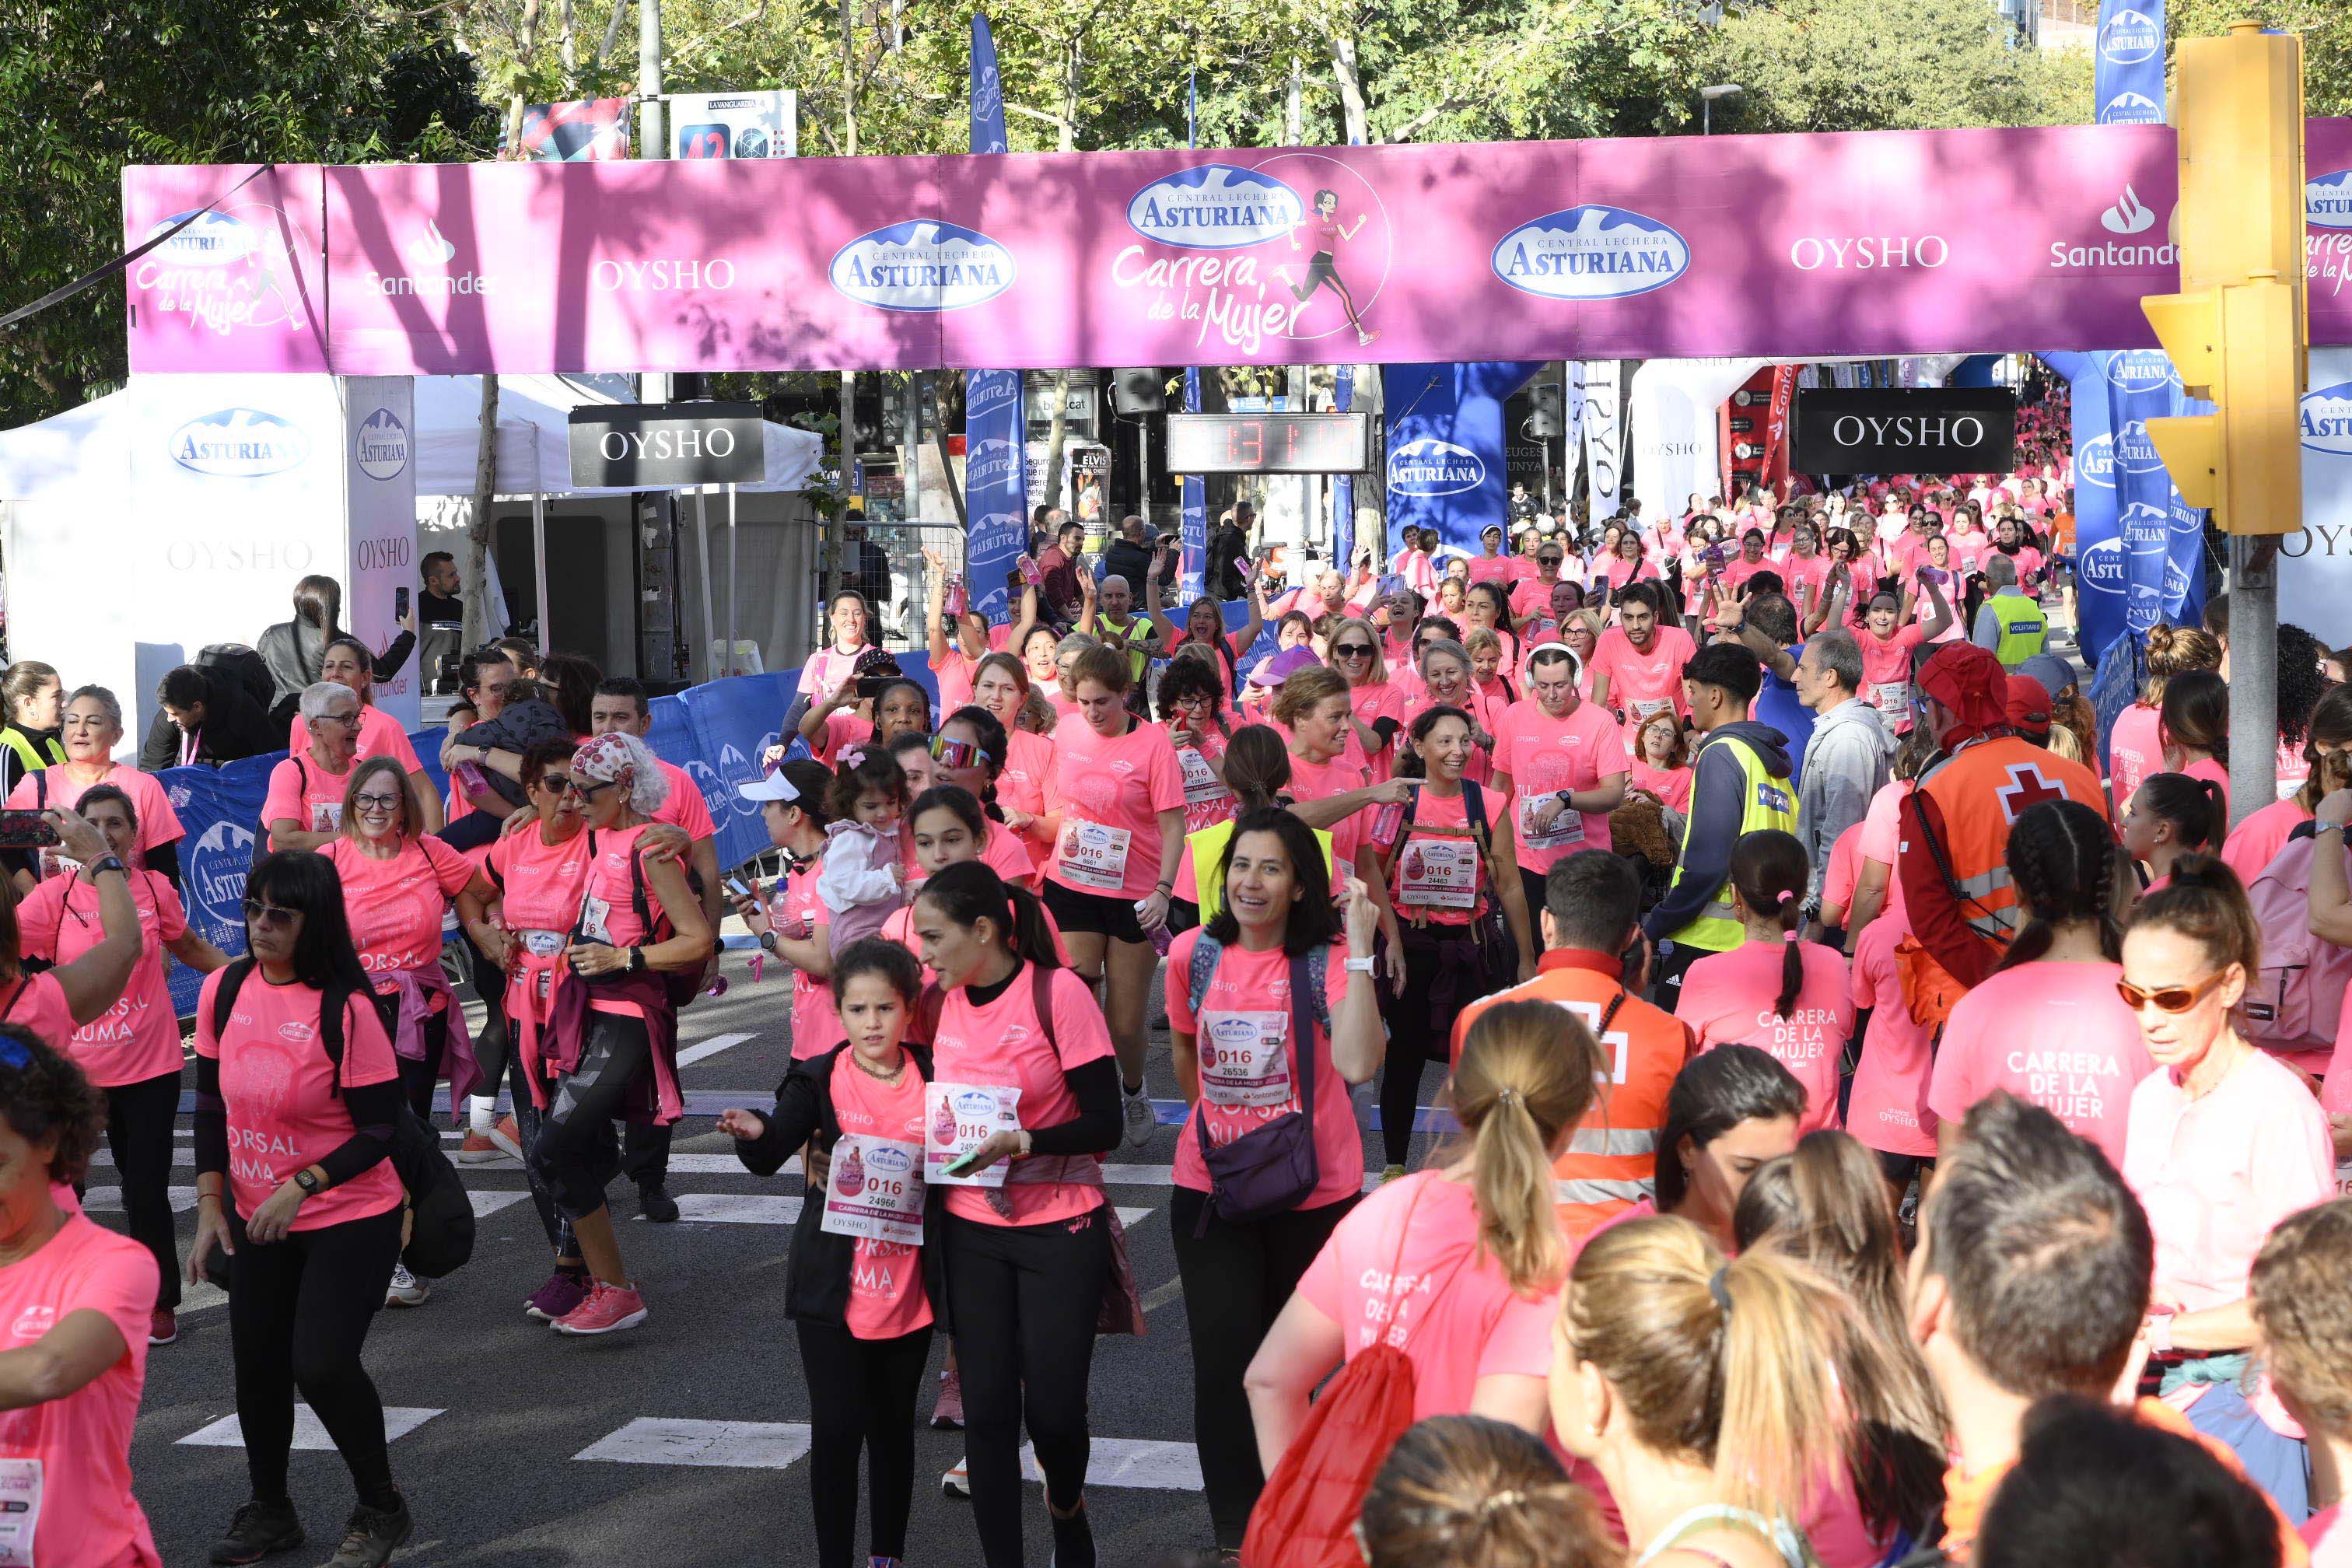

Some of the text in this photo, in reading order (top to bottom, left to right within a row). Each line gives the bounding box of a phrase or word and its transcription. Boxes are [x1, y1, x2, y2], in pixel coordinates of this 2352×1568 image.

[2106, 35, 2154, 51] ASTURIANA
[718, 100, 756, 109] VANGUARDIA
[1167, 193, 1286, 202] CENTRAL LECHERA
[1141, 197, 1290, 228] ASTURIANA
[1538, 236, 1668, 248] CENTRAL LECHERA
[873, 250, 996, 261] CENTRAL LECHERA
[1507, 242, 1675, 276] ASTURIANA
[1791, 236, 1948, 270] OYSHO
[2050, 241, 2180, 267] Santand
[846, 254, 1002, 288] ASTURIANA
[1111, 245, 1258, 287] Carrera
[2323, 257, 2337, 278] la
[136, 261, 227, 290] Carrera
[365, 271, 498, 296] Santander
[593, 259, 736, 291] OYSHO
[159, 288, 262, 335] de la Mujer
[1147, 283, 1312, 356] de la Mujer
[1833, 415, 1984, 447] OYSHO
[360, 434, 404, 463] ASTURIANA
[600, 429, 735, 460] OYSHO
[1083, 455, 1106, 465] ELVIS
[1026, 478, 1050, 488] quiere
[1391, 467, 1478, 483] ASTURIANA
[2278, 525, 2352, 558] OY
[167, 540, 313, 571] OYSHO
[358, 537, 409, 571] OYSHO
[370, 677, 408, 699] ntander
[2114, 746, 2145, 765] CARRERA
[1188, 768, 1207, 778] 016
[2119, 760, 2138, 773] DE LA
[2116, 772, 2140, 787] MUJER
[1517, 784, 1531, 797] TU
[1081, 846, 1103, 859] 016
[1427, 850, 1454, 859] ASTURIANA
[1426, 866, 1451, 876] 016
[359, 950, 423, 971] ORSAL
[231, 1012, 252, 1026] SHO
[1757, 1009, 1837, 1027] CARRERA
[1215, 1028, 1254, 1037] ASTURIANA
[1775, 1026, 1823, 1043] DE LA
[1218, 1050, 1252, 1064] 016
[1770, 1042, 1824, 1059] MUJER
[1222, 1067, 1248, 1076] 26536
[2007, 1051, 2119, 1077] CARRERA
[1244, 1078, 1262, 1087] MUJER
[2029, 1073, 2098, 1097] DE LA
[1251, 1089, 1284, 1100] Santander
[957, 1101, 992, 1111] ASTURIANA
[1214, 1094, 1303, 1118] ORSAL
[1879, 1111, 1919, 1128] OYSHO
[959, 1124, 989, 1138] 016
[870, 1153, 908, 1167] ASTURIANA
[868, 1177, 902, 1195] 016
[2336, 1179, 2352, 1193] 16
[838, 1205, 869, 1215] CARRERA
[869, 1196, 896, 1208] 24966
[833, 1218, 916, 1237] OYSHO Santander
[855, 1265, 894, 1290] MA
